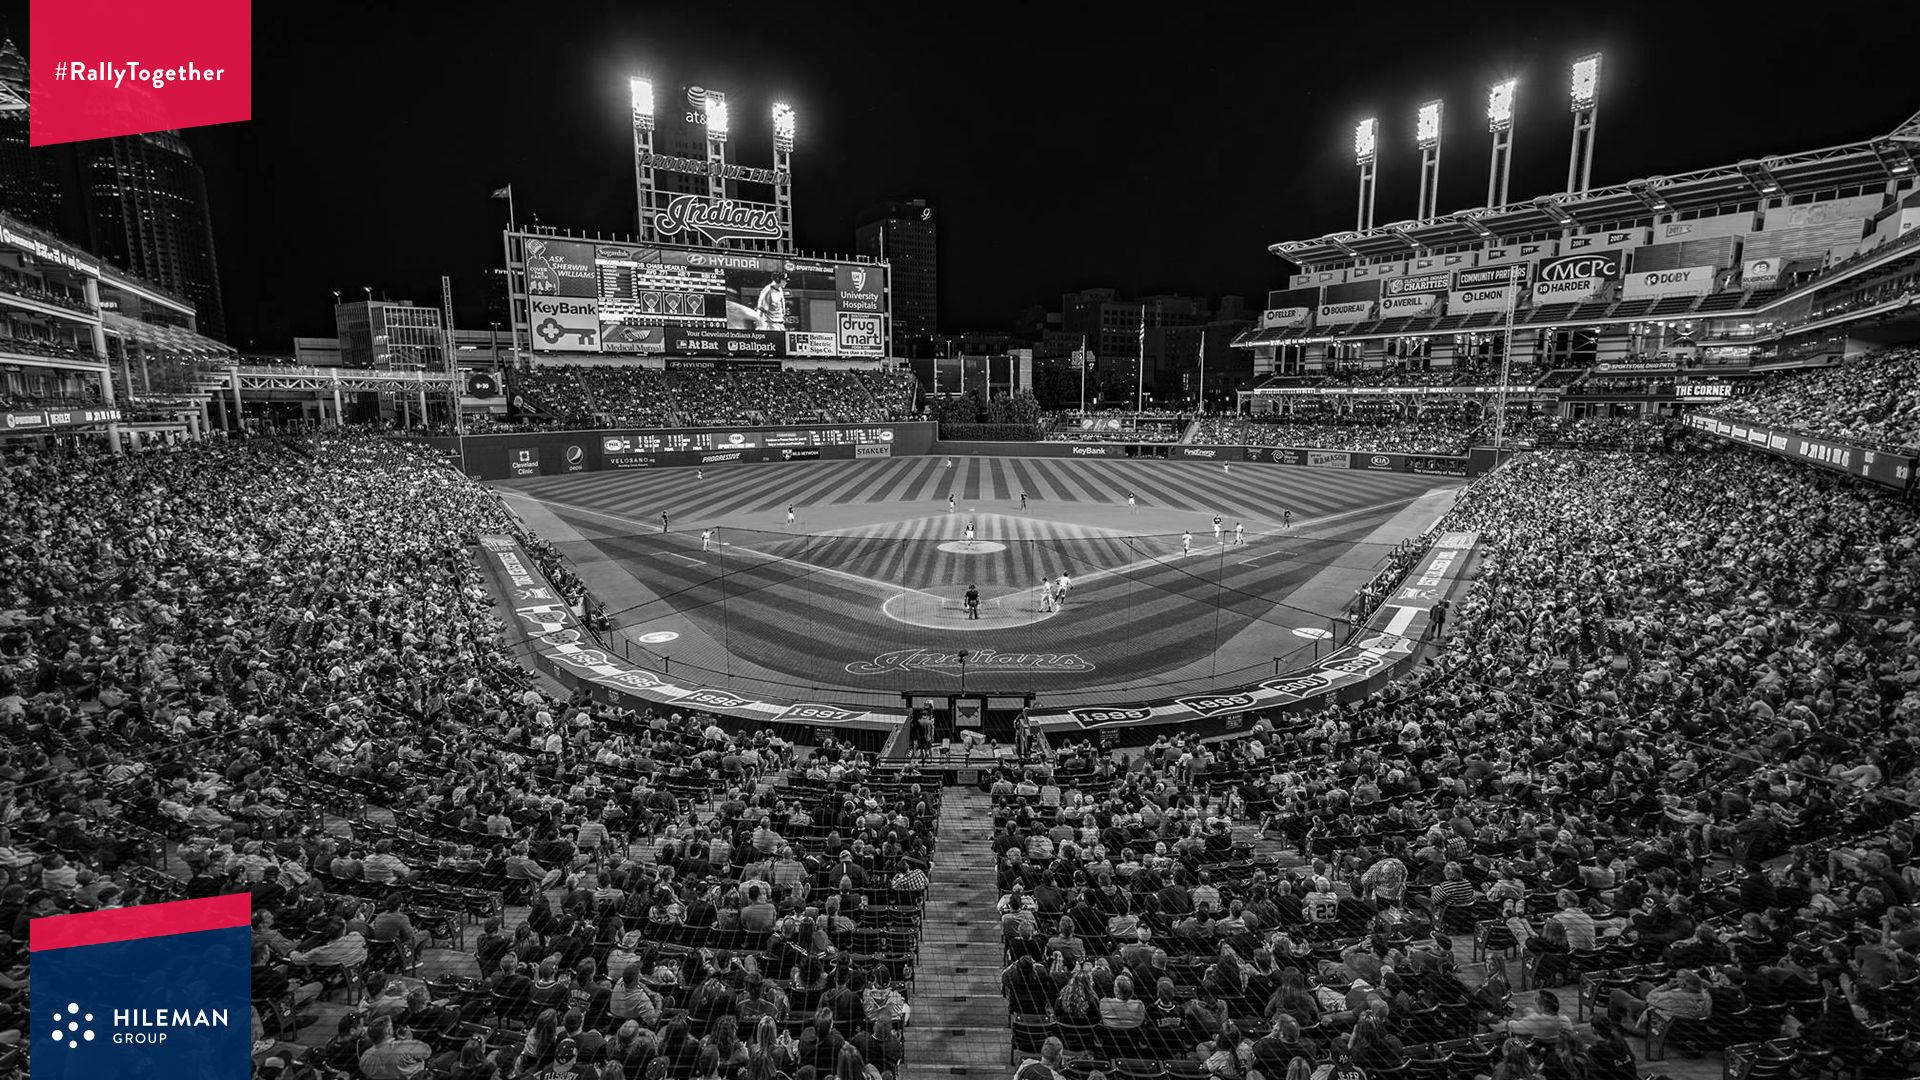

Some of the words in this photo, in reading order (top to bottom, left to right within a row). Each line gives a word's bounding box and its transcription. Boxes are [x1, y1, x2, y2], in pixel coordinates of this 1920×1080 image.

[686, 111, 707, 124] at&
[654, 194, 783, 244] Indians
[552, 263, 588, 271] SHERWIN
[708, 257, 760, 269] HYUNDAI
[557, 271, 596, 279] WILLIAMS
[1461, 271, 1494, 284] COMMUNITY
[1495, 267, 1526, 280] PARTRS
[1661, 272, 1690, 283] DOBY
[1403, 280, 1448, 291] CHARITIES
[1551, 280, 1590, 292] HARDER
[841, 291, 879, 302] University
[1474, 291, 1503, 300] LEMON
[843, 300, 877, 310] Hospitals
[1393, 297, 1422, 307] AVERILL
[532, 301, 596, 316] KeyBank
[1275, 310, 1296, 318] FELLER
[1330, 304, 1365, 314] BOUDREAU
[843, 314, 875, 334] drug
[846, 333, 882, 345] mart
[688, 340, 700, 349] At
[701, 341, 719, 350] Bat
[739, 342, 776, 352] Ballpark
[1675, 385, 1693, 397] THE
[1694, 385, 1732, 397] CORNER
[857, 447, 889, 455] STANLEY
[1072, 446, 1106, 455] KeyBank
[702, 453, 741, 463] PROGRESSIVE
[512, 461, 539, 469] Cleveland
[1274, 677, 1327, 692] 2001
[686, 692, 743, 707] 1996
[788, 707, 851, 720] 1997
[1079, 709, 1144, 722] 1998
[1316, 903, 1336, 919] 23
